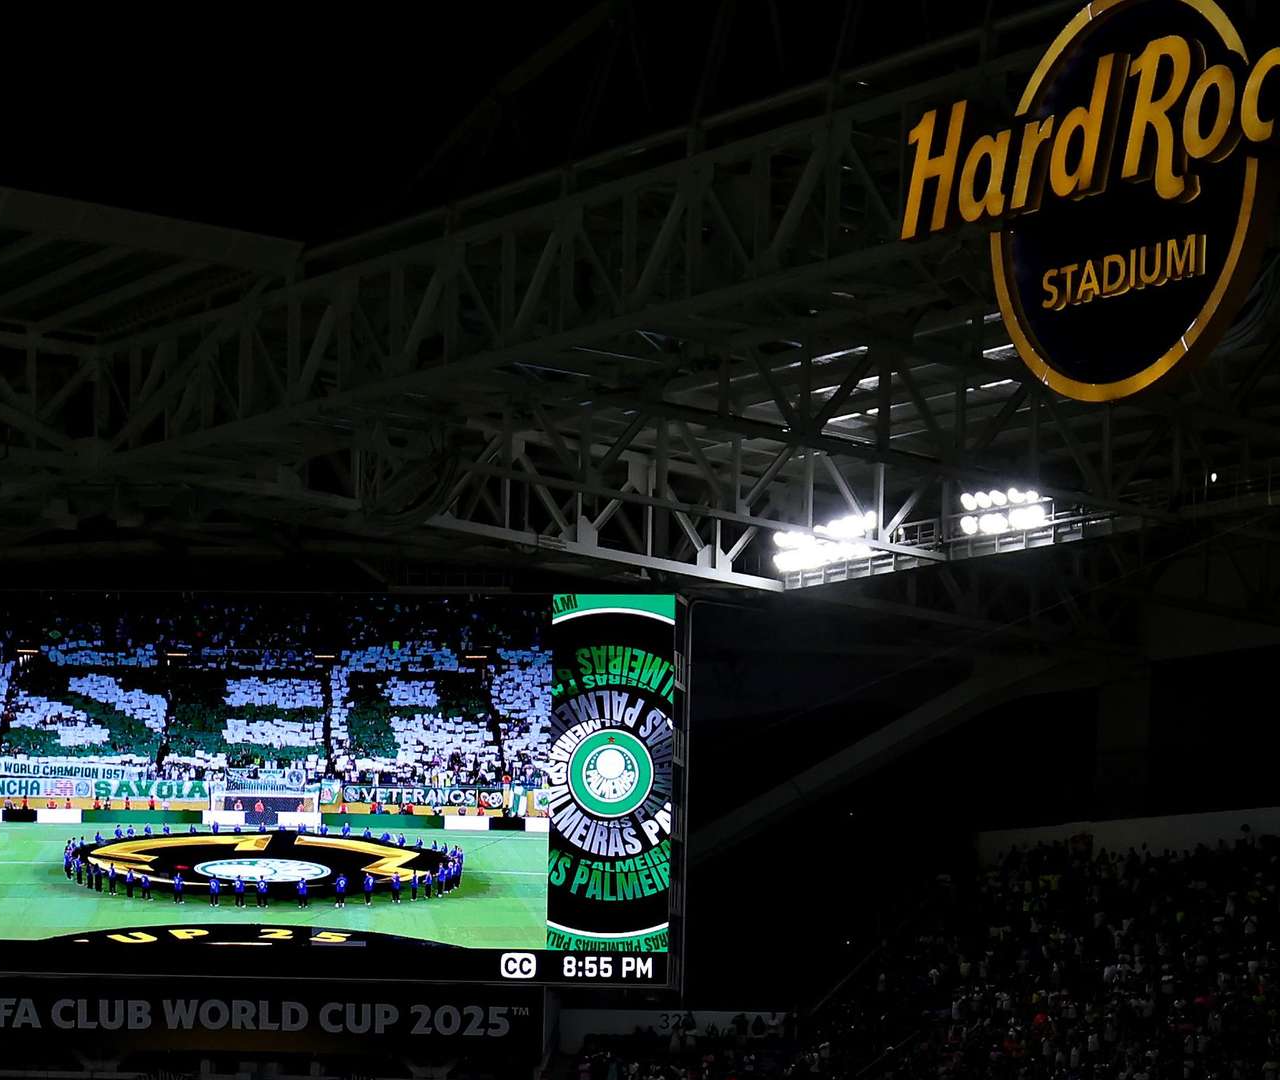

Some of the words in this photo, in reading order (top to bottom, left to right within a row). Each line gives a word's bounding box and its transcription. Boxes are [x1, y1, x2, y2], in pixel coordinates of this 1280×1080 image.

[901, 53, 1116, 240] Hard
[1042, 234, 1200, 311] STADIUM
[4, 761, 40, 776] WORLD
[42, 765, 98, 780] CHAMPION
[359, 788, 477, 806] VETERANOS
[504, 957, 532, 976] CC
[563, 956, 613, 978] 8:55
[622, 957, 653, 979] PM
[51, 998, 152, 1030] CLUB
[161, 999, 309, 1032] WORLD
[319, 1002, 400, 1035] CUP
